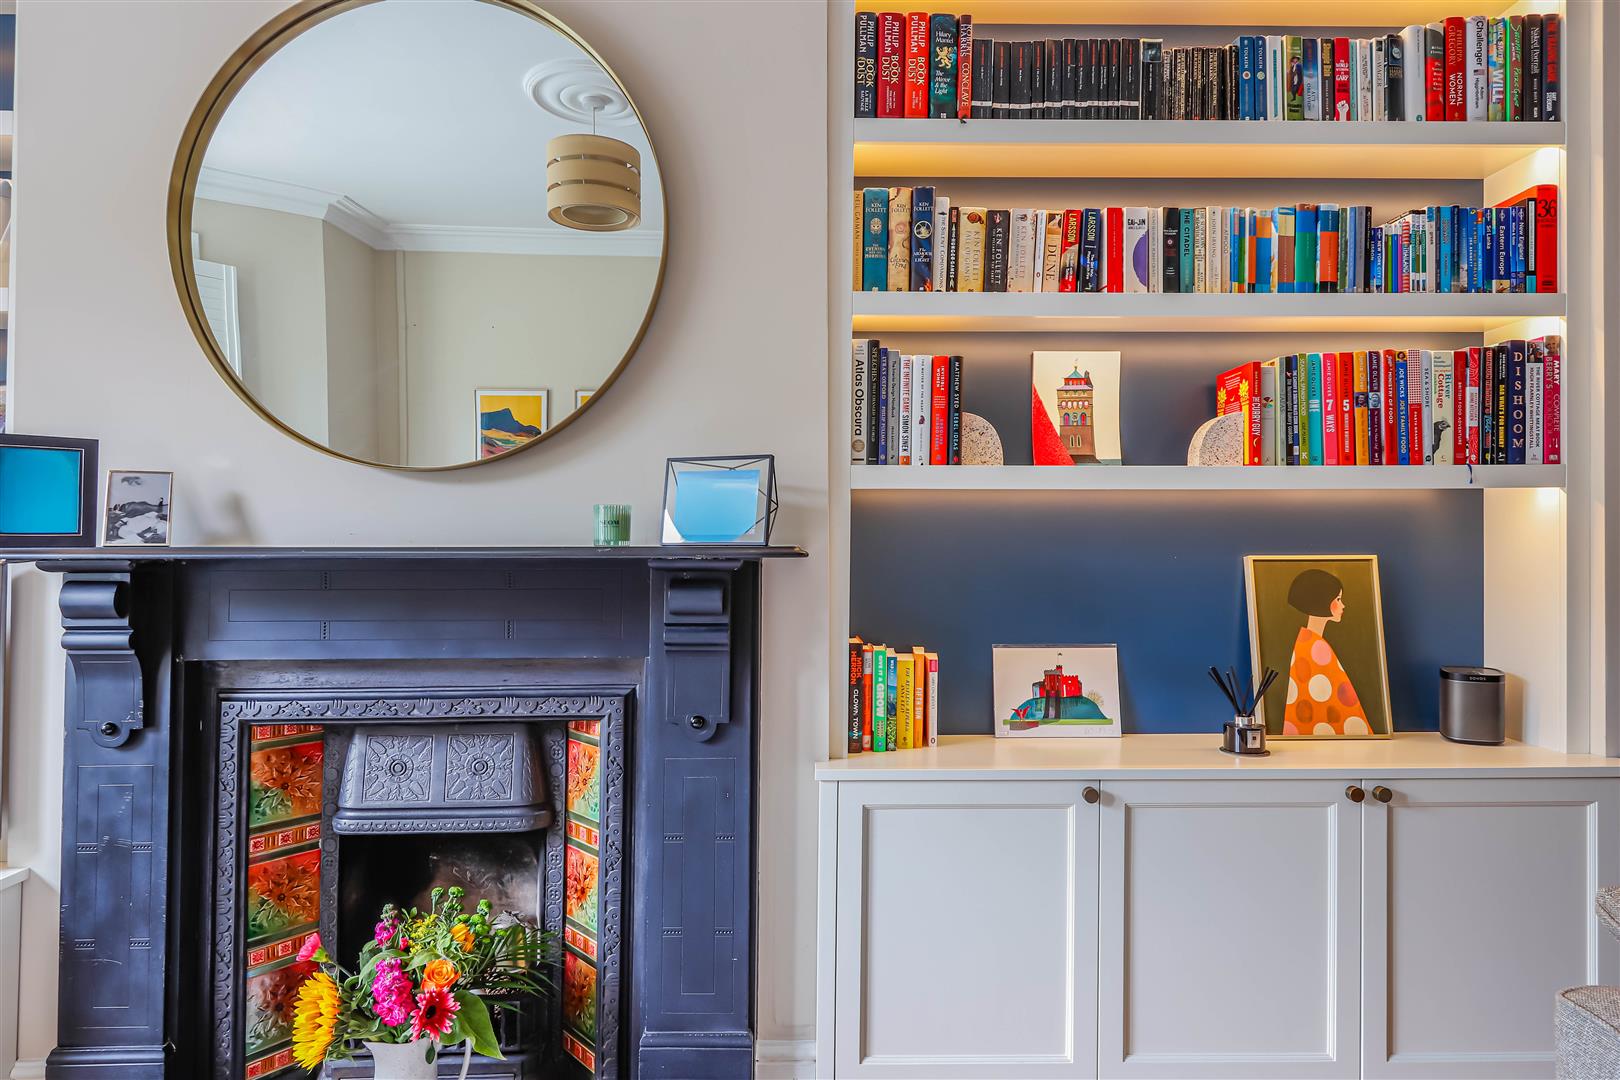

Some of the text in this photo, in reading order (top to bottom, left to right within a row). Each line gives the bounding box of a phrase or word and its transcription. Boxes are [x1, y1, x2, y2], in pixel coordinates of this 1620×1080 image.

[859, 15, 867, 52] PULLMAN
[960, 24, 968, 57] HARRIS
[1448, 25, 1456, 66] GREGORY
[1475, 20, 1484, 66] Challenger
[857, 60, 865, 85] DUST
[866, 58, 874, 87] BOOK
[882, 57, 890, 82] DUST
[908, 58, 916, 84] DUST
[961, 62, 970, 107] CONCLAVE
[1492, 69, 1503, 103] WILL
[1538, 200, 1557, 218] 36
[1067, 213, 1076, 243] LARSSON
[1087, 211, 1096, 241] LARSSON
[965, 247, 971, 255] OF
[972, 249, 981, 282] FOLLETT
[1046, 244, 1057, 281] DUNE
[1445, 374, 1453, 399] River
[1545, 356, 1553, 389] BERRY'S
[855, 359, 865, 436] Atlas Obscura
[1309, 399, 1320, 412] ONE
[1343, 399, 1349, 412] 5
[1436, 373, 1445, 409] Cottage
[1251, 402, 1261, 436] CURRY GUY
[1326, 399, 1335, 433] 7 WAYS
[901, 435, 909, 453] SINEK
[876, 683, 885, 718] GROW
